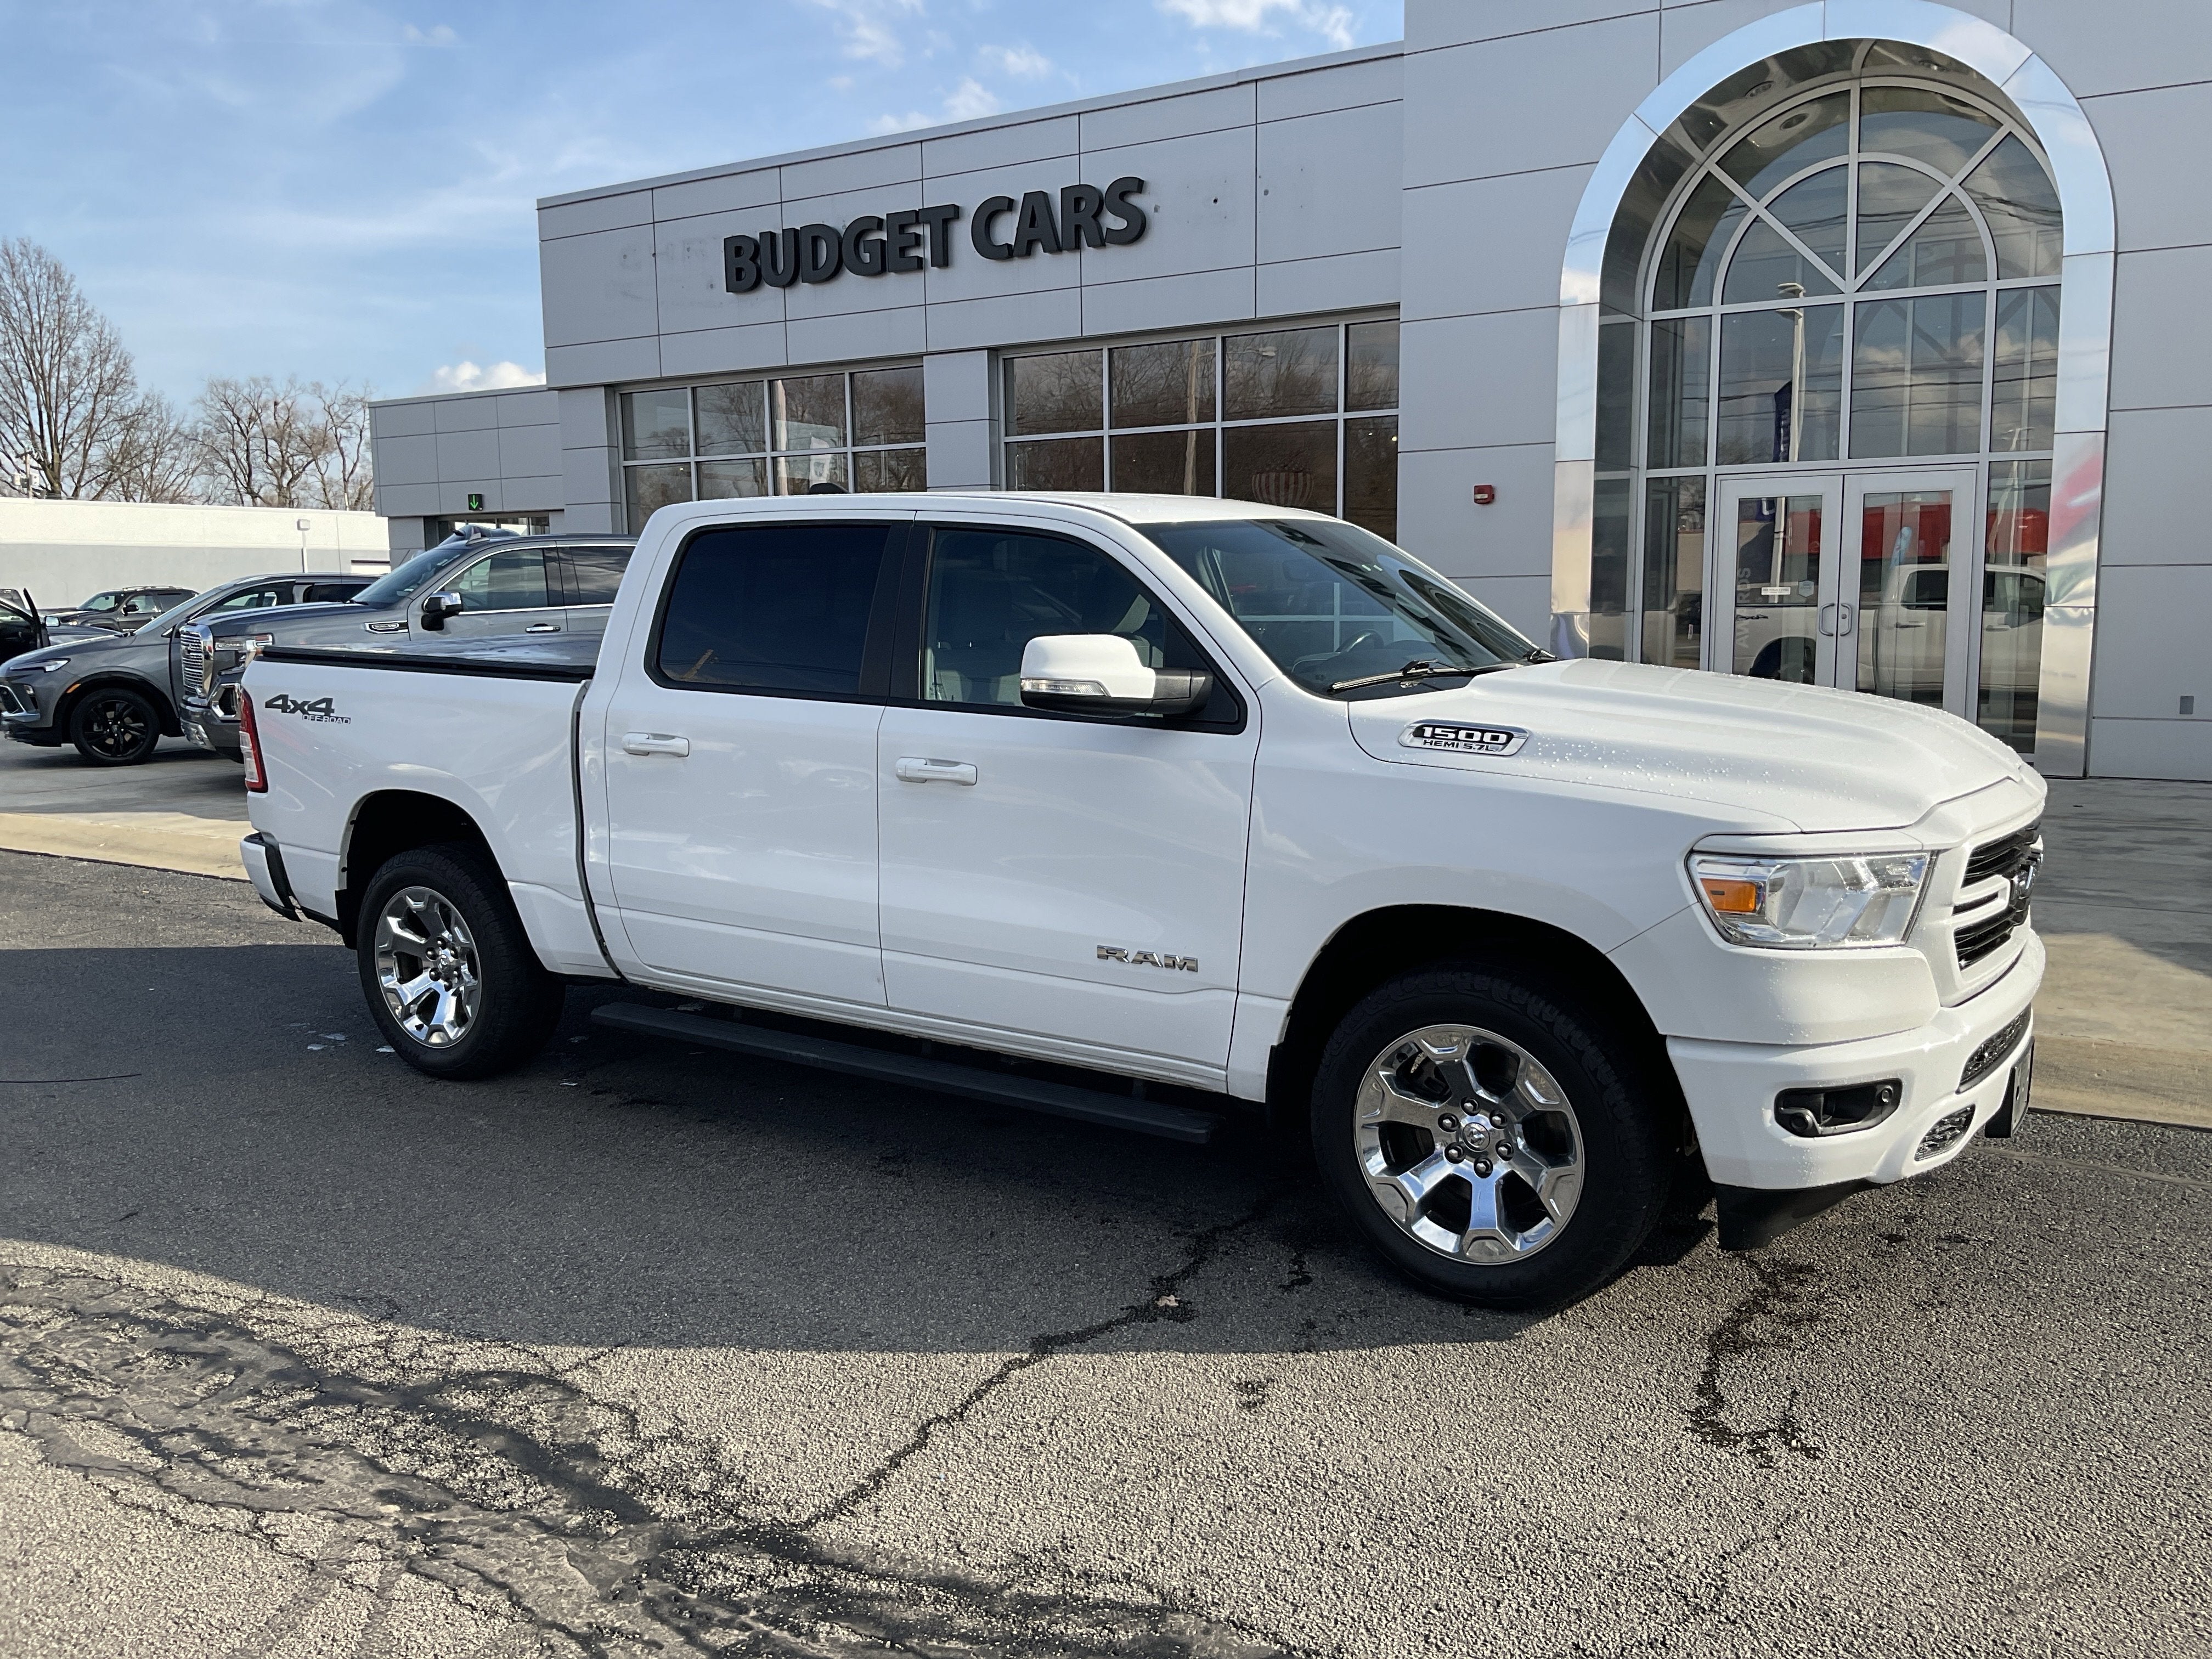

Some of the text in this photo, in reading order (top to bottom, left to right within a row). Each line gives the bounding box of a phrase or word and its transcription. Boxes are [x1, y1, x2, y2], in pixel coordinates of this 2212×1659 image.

[724, 176, 1146, 294] BUDGET CARS
[1423, 726, 1508, 743] 1500
[1423, 739, 1494, 752] HEMI 5.7L
[1097, 945, 1198, 972] RAM
